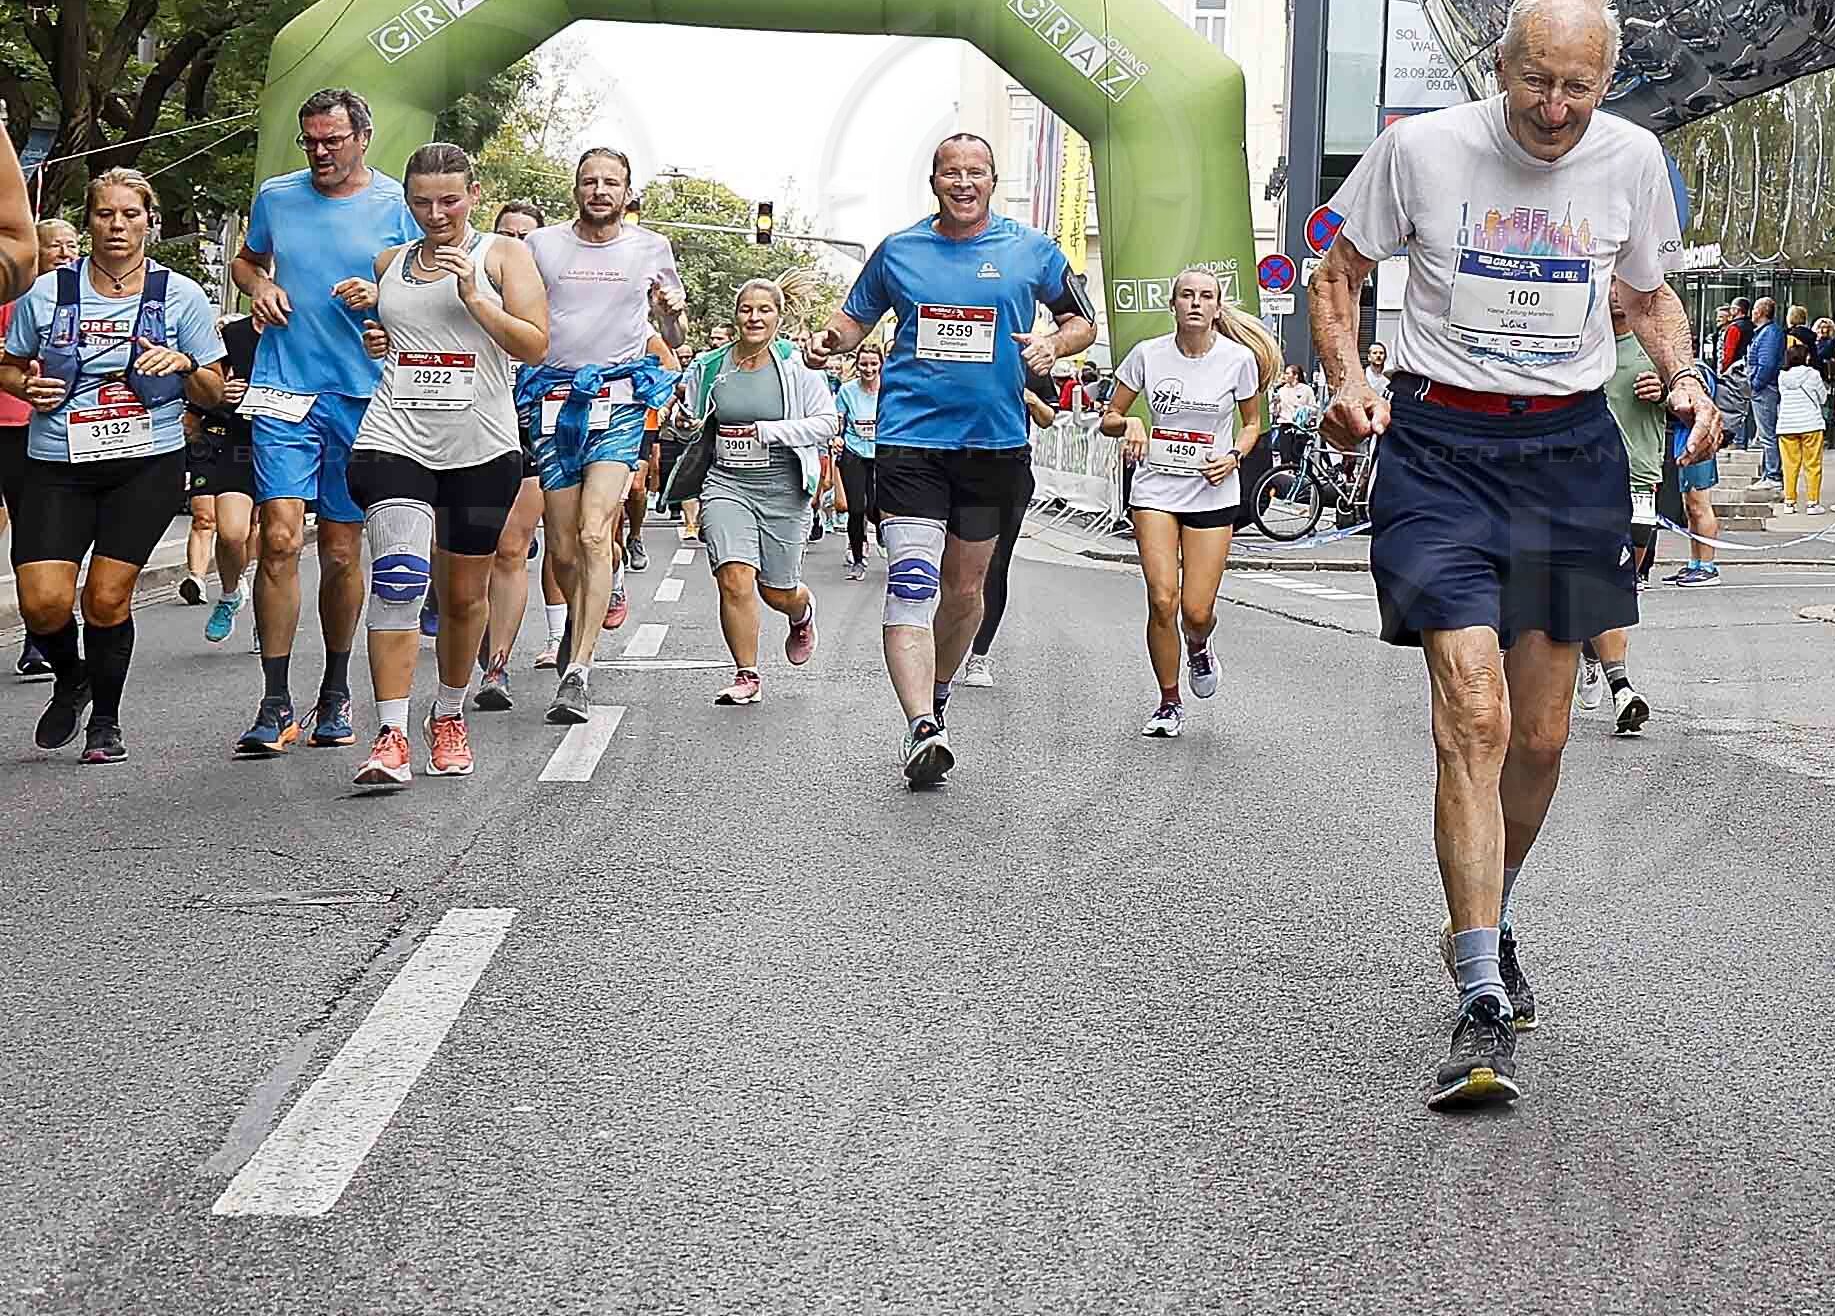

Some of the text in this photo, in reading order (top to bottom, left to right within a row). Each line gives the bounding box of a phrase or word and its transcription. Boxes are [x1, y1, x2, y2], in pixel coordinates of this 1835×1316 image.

[1395, 29, 1421, 40] SOL
[1411, 42, 1441, 52] WAL
[1394, 68, 1453, 78] 28.09.202
[1683, 240, 1721, 269] elcome
[1115, 276, 1234, 311] GRZ
[1508, 290, 1540, 306] 100
[937, 323, 973, 337] 2559
[413, 369, 452, 385] 2922
[91, 421, 131, 437] 3132
[725, 440, 752, 450] 3901
[1166, 444, 1196, 457] 4450
